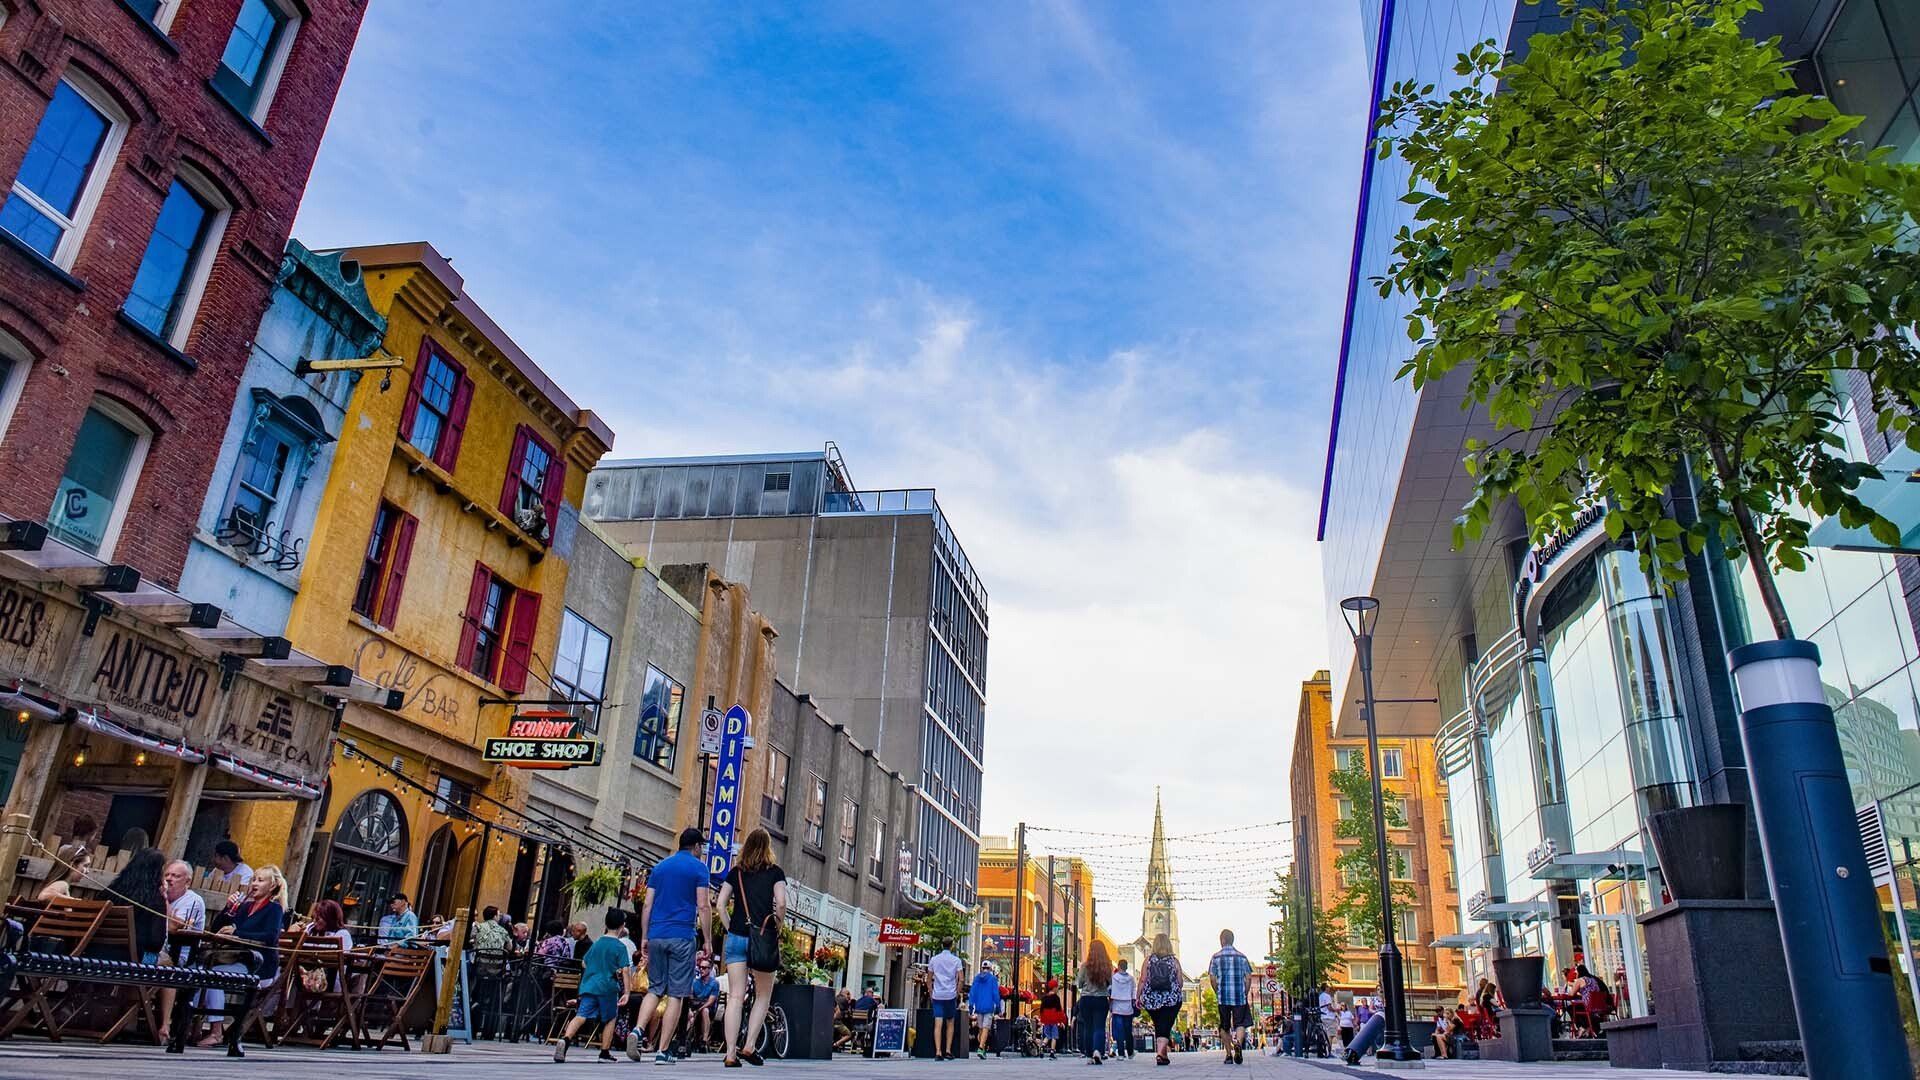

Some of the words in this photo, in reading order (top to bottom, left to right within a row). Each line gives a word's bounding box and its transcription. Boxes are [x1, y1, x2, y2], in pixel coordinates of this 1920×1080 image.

[109, 690, 140, 709] TACOS
[142, 702, 179, 723] TEQUILA
[422, 687, 460, 726] BAR
[222, 723, 312, 766] AZTECA
[510, 719, 576, 738] ECONOMY
[490, 742, 536, 757] SHOE
[541, 743, 589, 758] SHOP
[710, 718, 742, 874] DIAMOND
